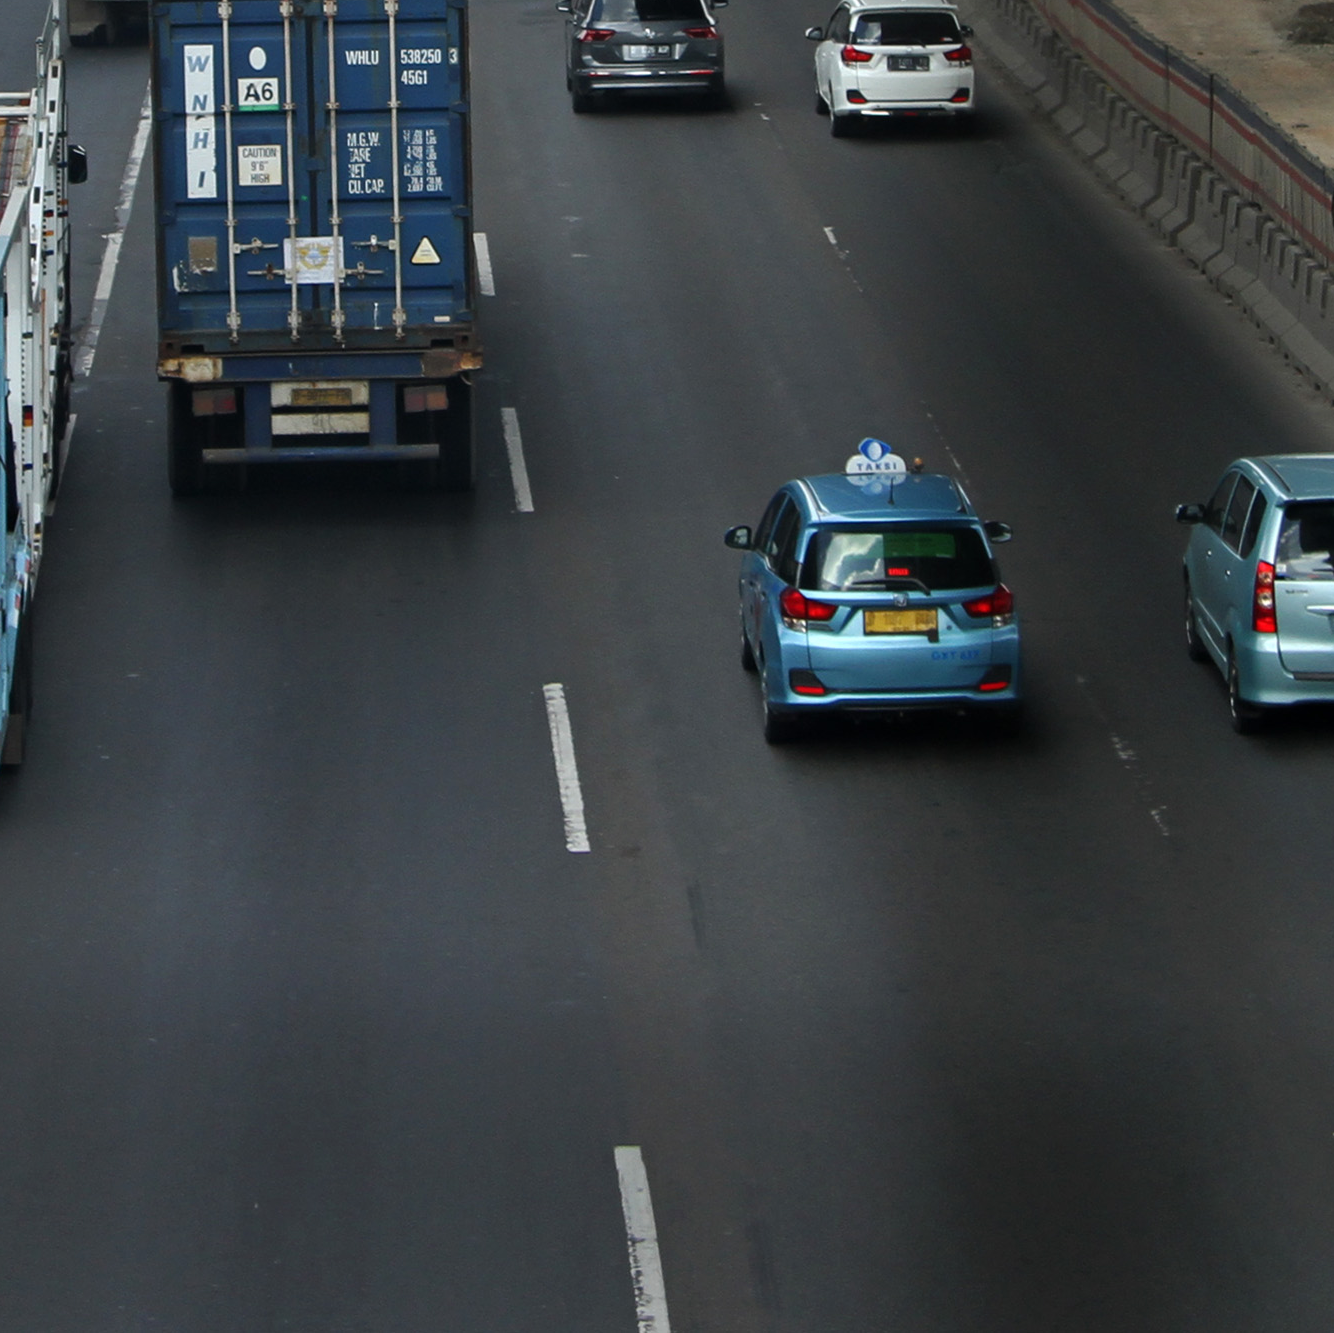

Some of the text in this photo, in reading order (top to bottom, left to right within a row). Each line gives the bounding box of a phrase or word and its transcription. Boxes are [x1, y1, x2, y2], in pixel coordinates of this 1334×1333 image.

[345, 48, 458, 65] WHLU 538250 3
[401, 70, 428, 85] 45G1
[243, 82, 274, 103] A6
[347, 132, 380, 147] M.G.W.
[242, 147, 277, 158] CAUTION
[250, 174, 270, 184] HIGH
[856, 462, 897, 472] TAKSI
